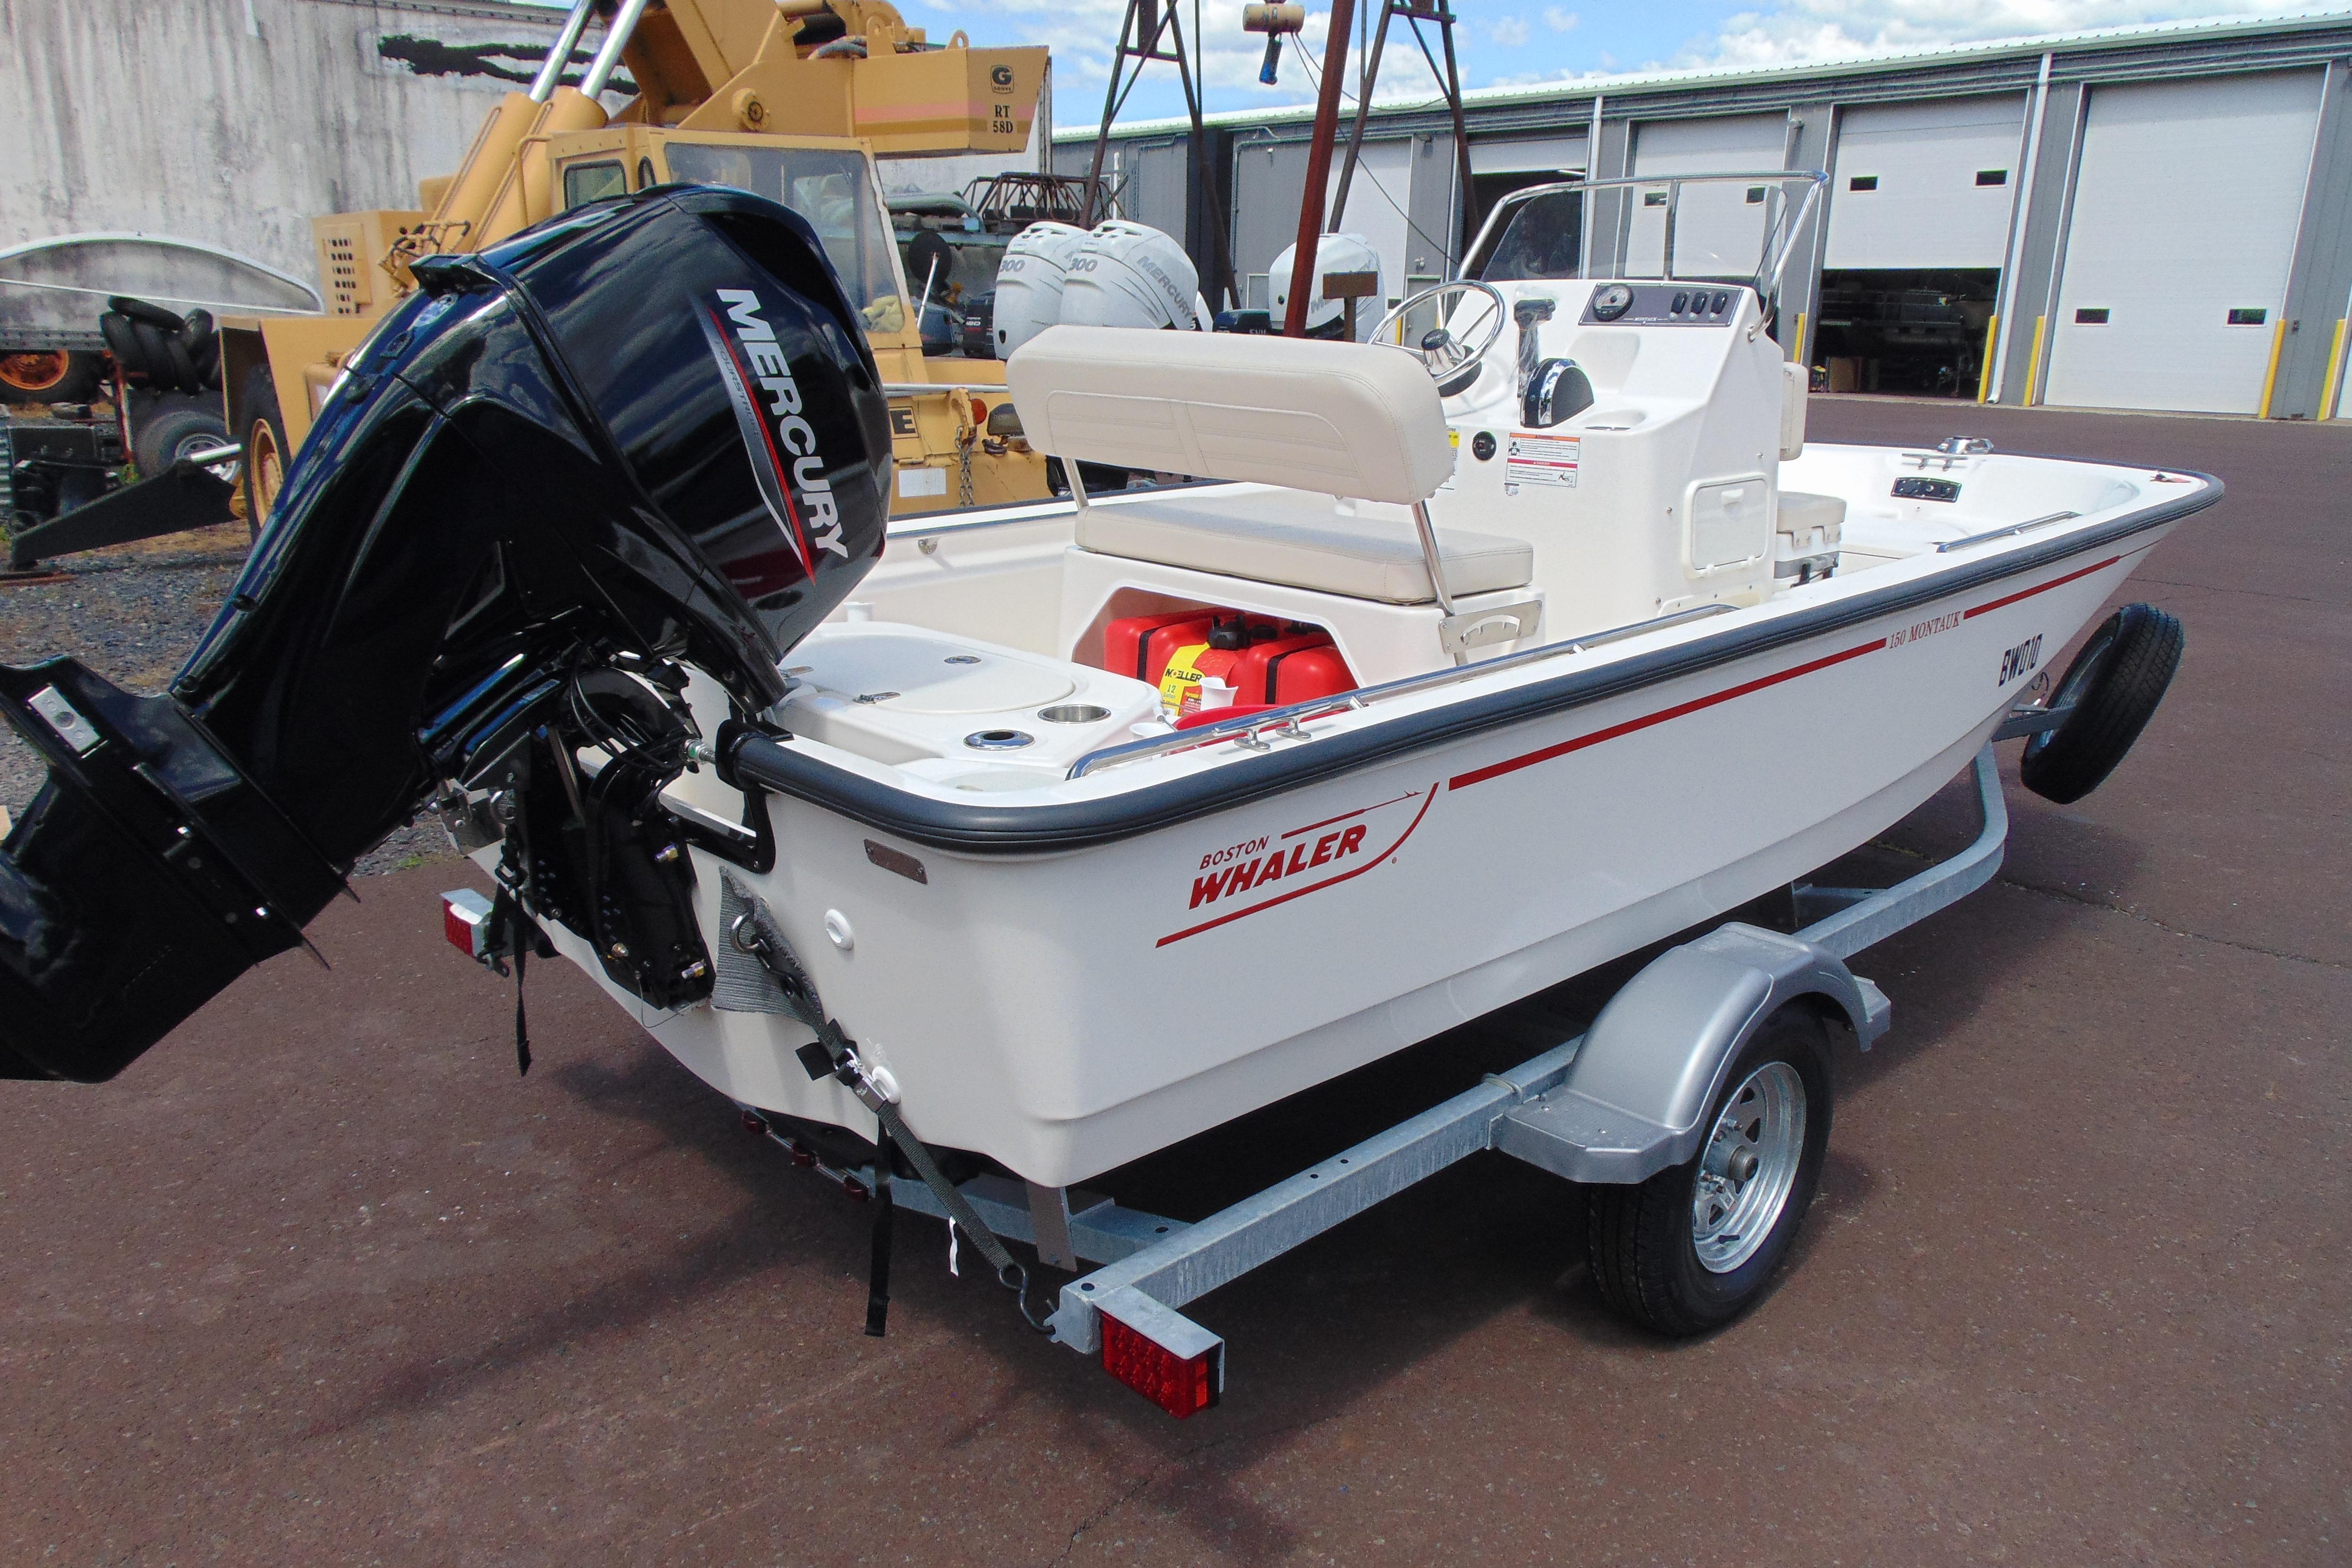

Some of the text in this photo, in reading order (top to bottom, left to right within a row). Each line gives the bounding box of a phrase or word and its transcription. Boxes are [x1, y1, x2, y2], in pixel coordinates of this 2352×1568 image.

[995, 104, 1010, 118] RT
[993, 121, 1013, 133] 58D
[1068, 258, 1098, 273] 300
[1137, 256, 1195, 318] MERCURY
[716, 288, 849, 559] MERCURY
[1889, 611, 1961, 649] 150 MONTAUK
[1165, 668, 1202, 683] MOELLER
[1167, 684, 1176, 693] 12
[1199, 835, 1270, 870] BOSTON
[1188, 824, 1367, 910] WHALER
